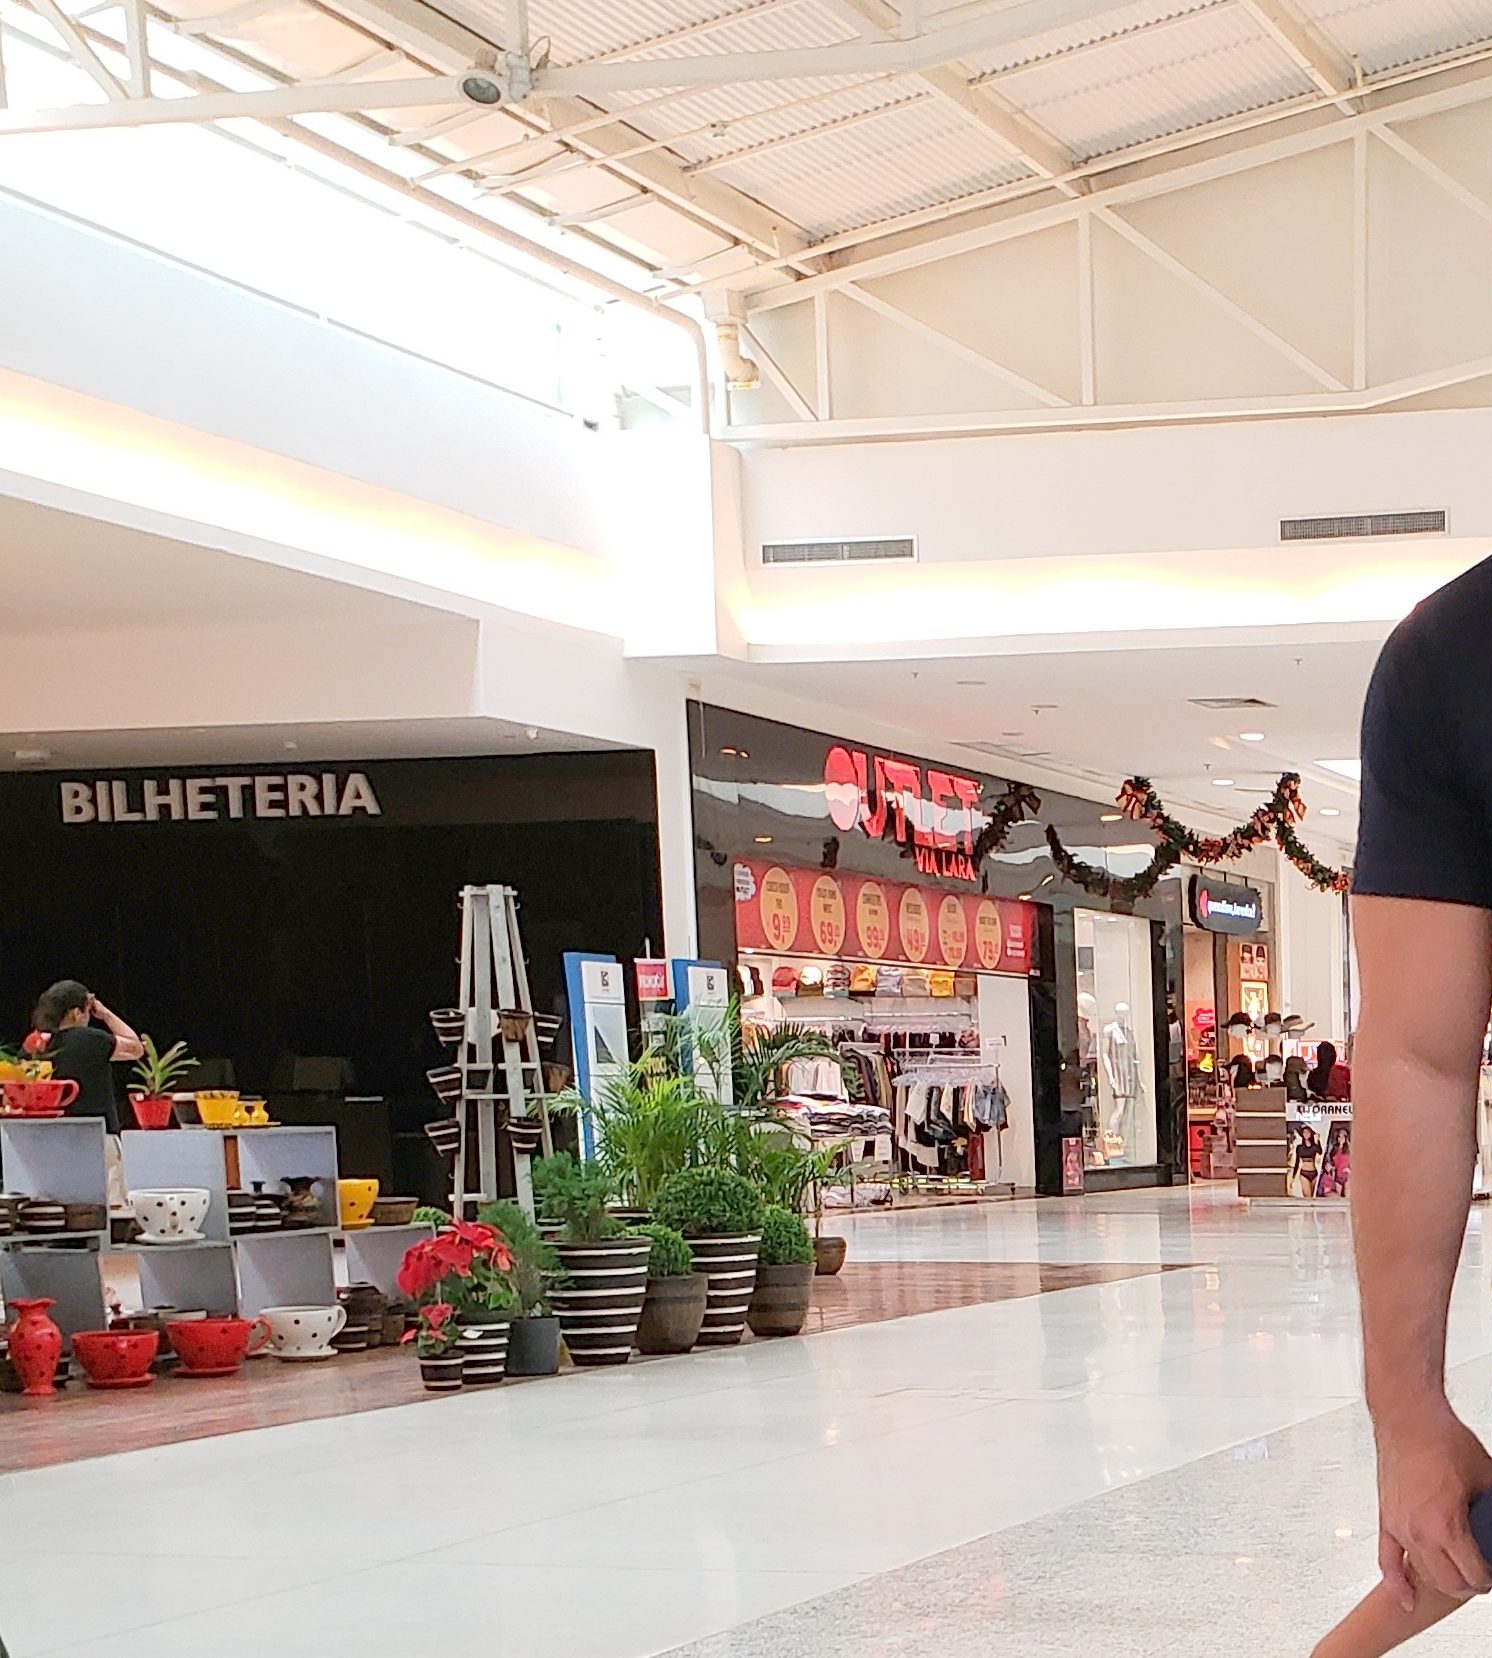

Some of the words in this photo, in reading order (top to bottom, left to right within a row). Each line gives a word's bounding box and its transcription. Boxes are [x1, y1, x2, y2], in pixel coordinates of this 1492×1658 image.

[60, 772, 382, 824] BILHETERIA
[824, 745, 981, 856] OUTLET
[914, 846, 941, 878] VIA
[941, 851, 977, 882] LARA
